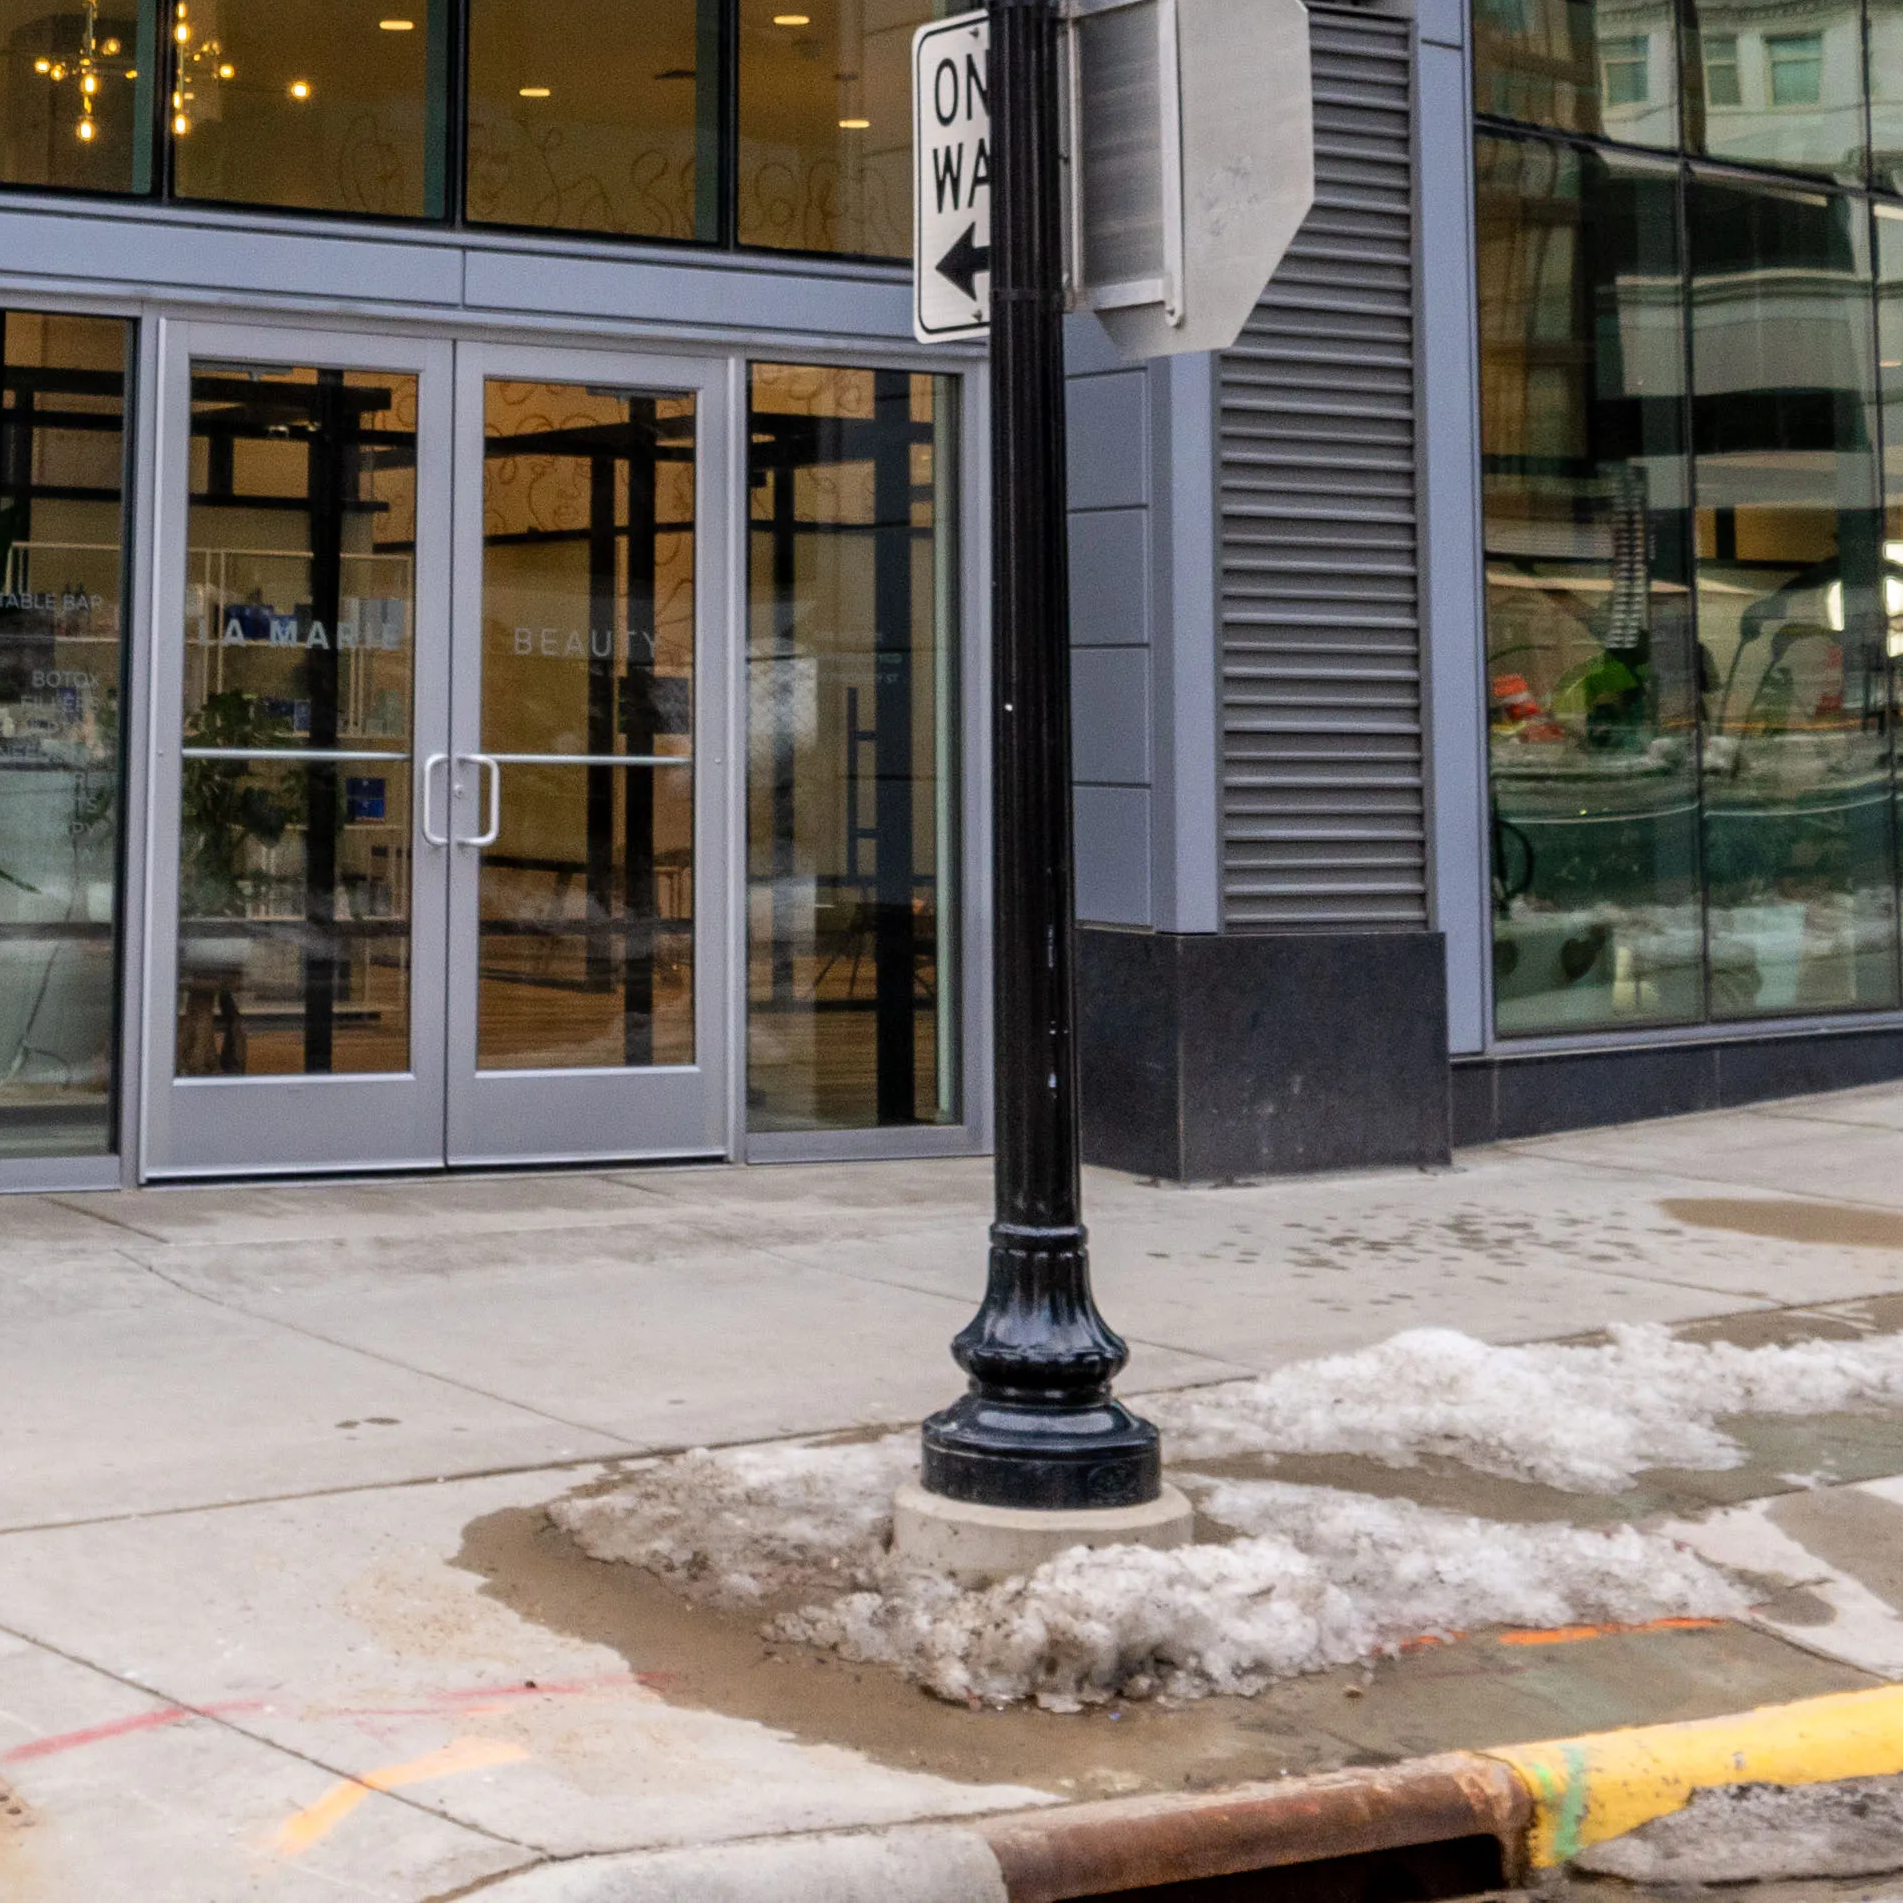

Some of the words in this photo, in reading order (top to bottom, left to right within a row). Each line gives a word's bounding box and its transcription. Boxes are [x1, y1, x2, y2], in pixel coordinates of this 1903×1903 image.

[934, 50, 991, 127] ON
[933, 137, 991, 214] WA
[62, 594, 102, 611] BAR
[197, 616, 246, 648] LA
[270, 618, 401, 651] MARIE
[514, 627, 663, 659] BEAUTY
[32, 671, 99, 689] BOTOX
